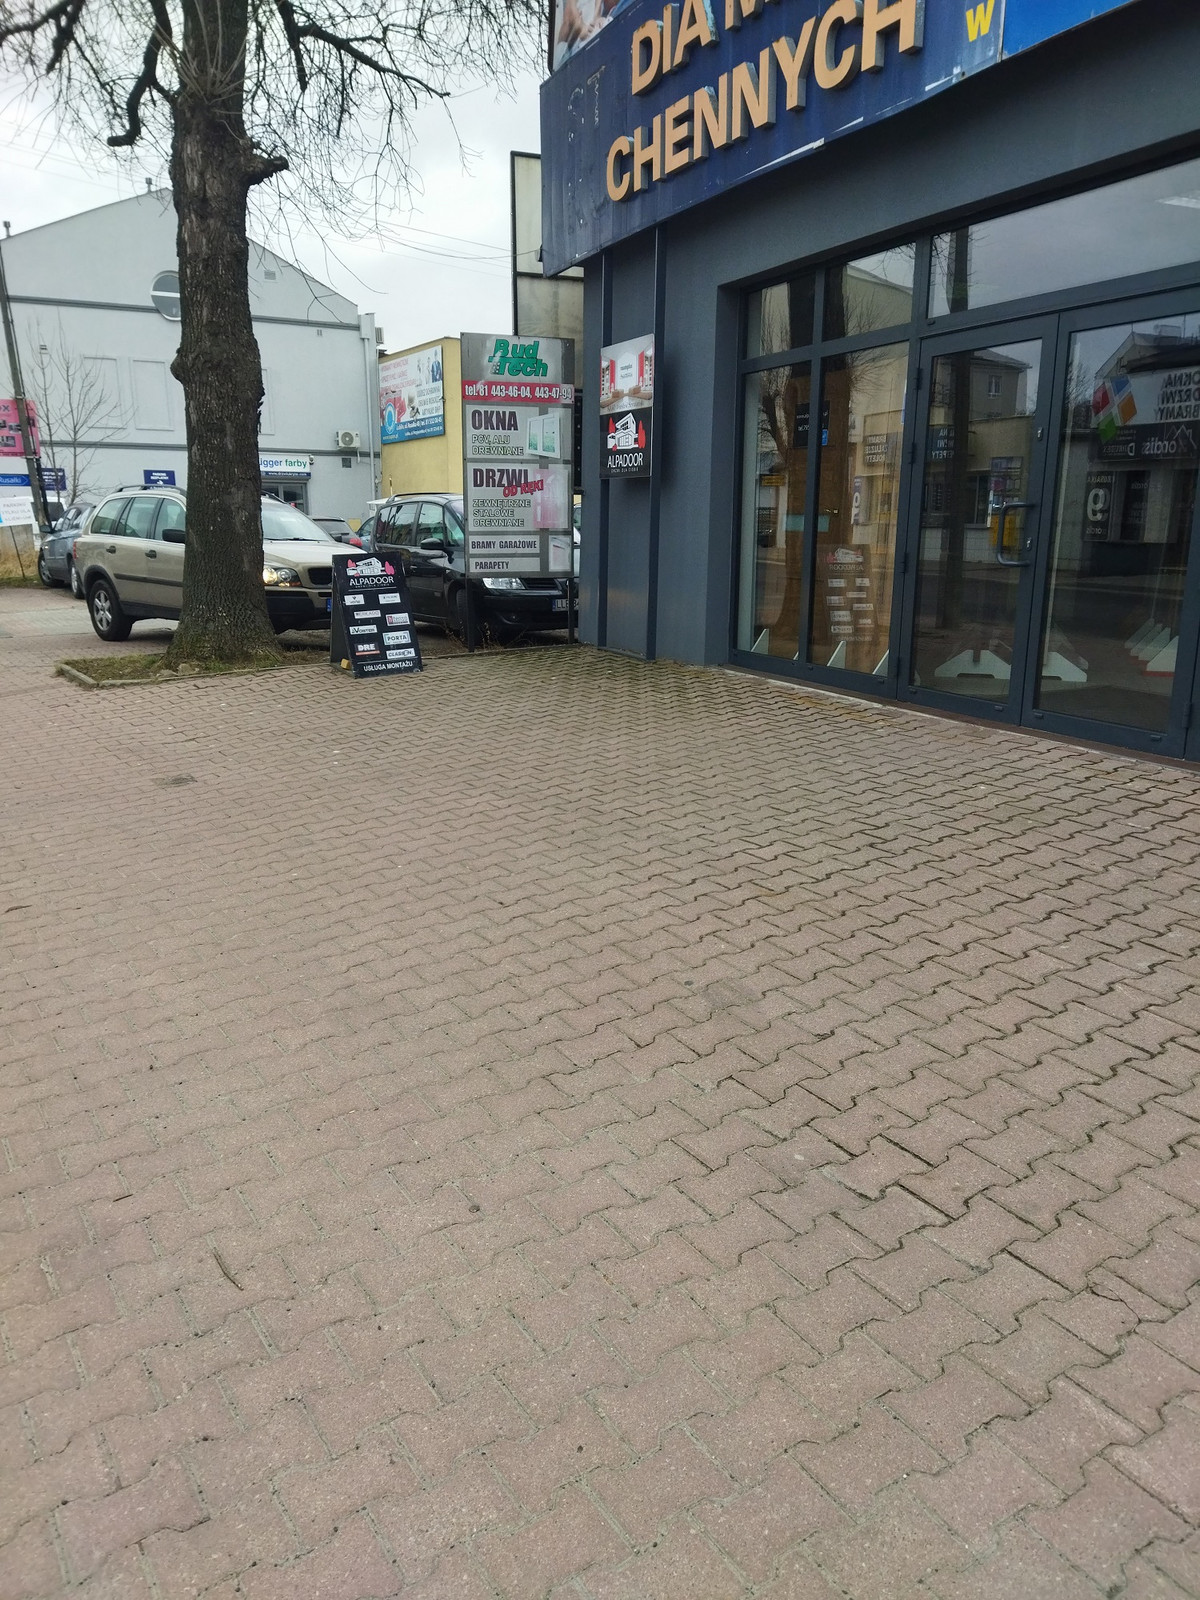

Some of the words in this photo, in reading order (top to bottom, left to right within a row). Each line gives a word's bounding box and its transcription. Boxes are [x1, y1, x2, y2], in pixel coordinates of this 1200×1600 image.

[606, 0, 924, 201] CHENNYCH
[493, 338, 540, 359] Bud
[465, 385, 478, 396] tel.
[479, 386, 488, 396] 81
[491, 386, 533, 399] 443-46-04,
[535, 386, 573, 399] 443-47-94
[471, 409, 519, 431] OKNA
[492, 435, 511, 445] ALU
[471, 446, 524, 456] DREWNIANE
[285, 458, 307, 469] farby
[607, 453, 643, 468] ALPADOOR
[473, 468, 529, 488] DRZWI
[502, 486, 518, 498] OD
[520, 479, 544, 495] RĘKI
[472, 499, 531, 509] ZEWNĘTRZNE
[473, 508, 515, 518] STALOWE
[473, 518, 525, 528] DREWNIANE
[471, 541, 496, 550] BRAMY
[499, 539, 537, 550] GARAŻOWE
[475, 560, 510, 571] PARAPETY
[349, 576, 395, 586] ALPADOOR
[387, 634, 407, 642] PORTA
[357, 643, 376, 652] DRE
